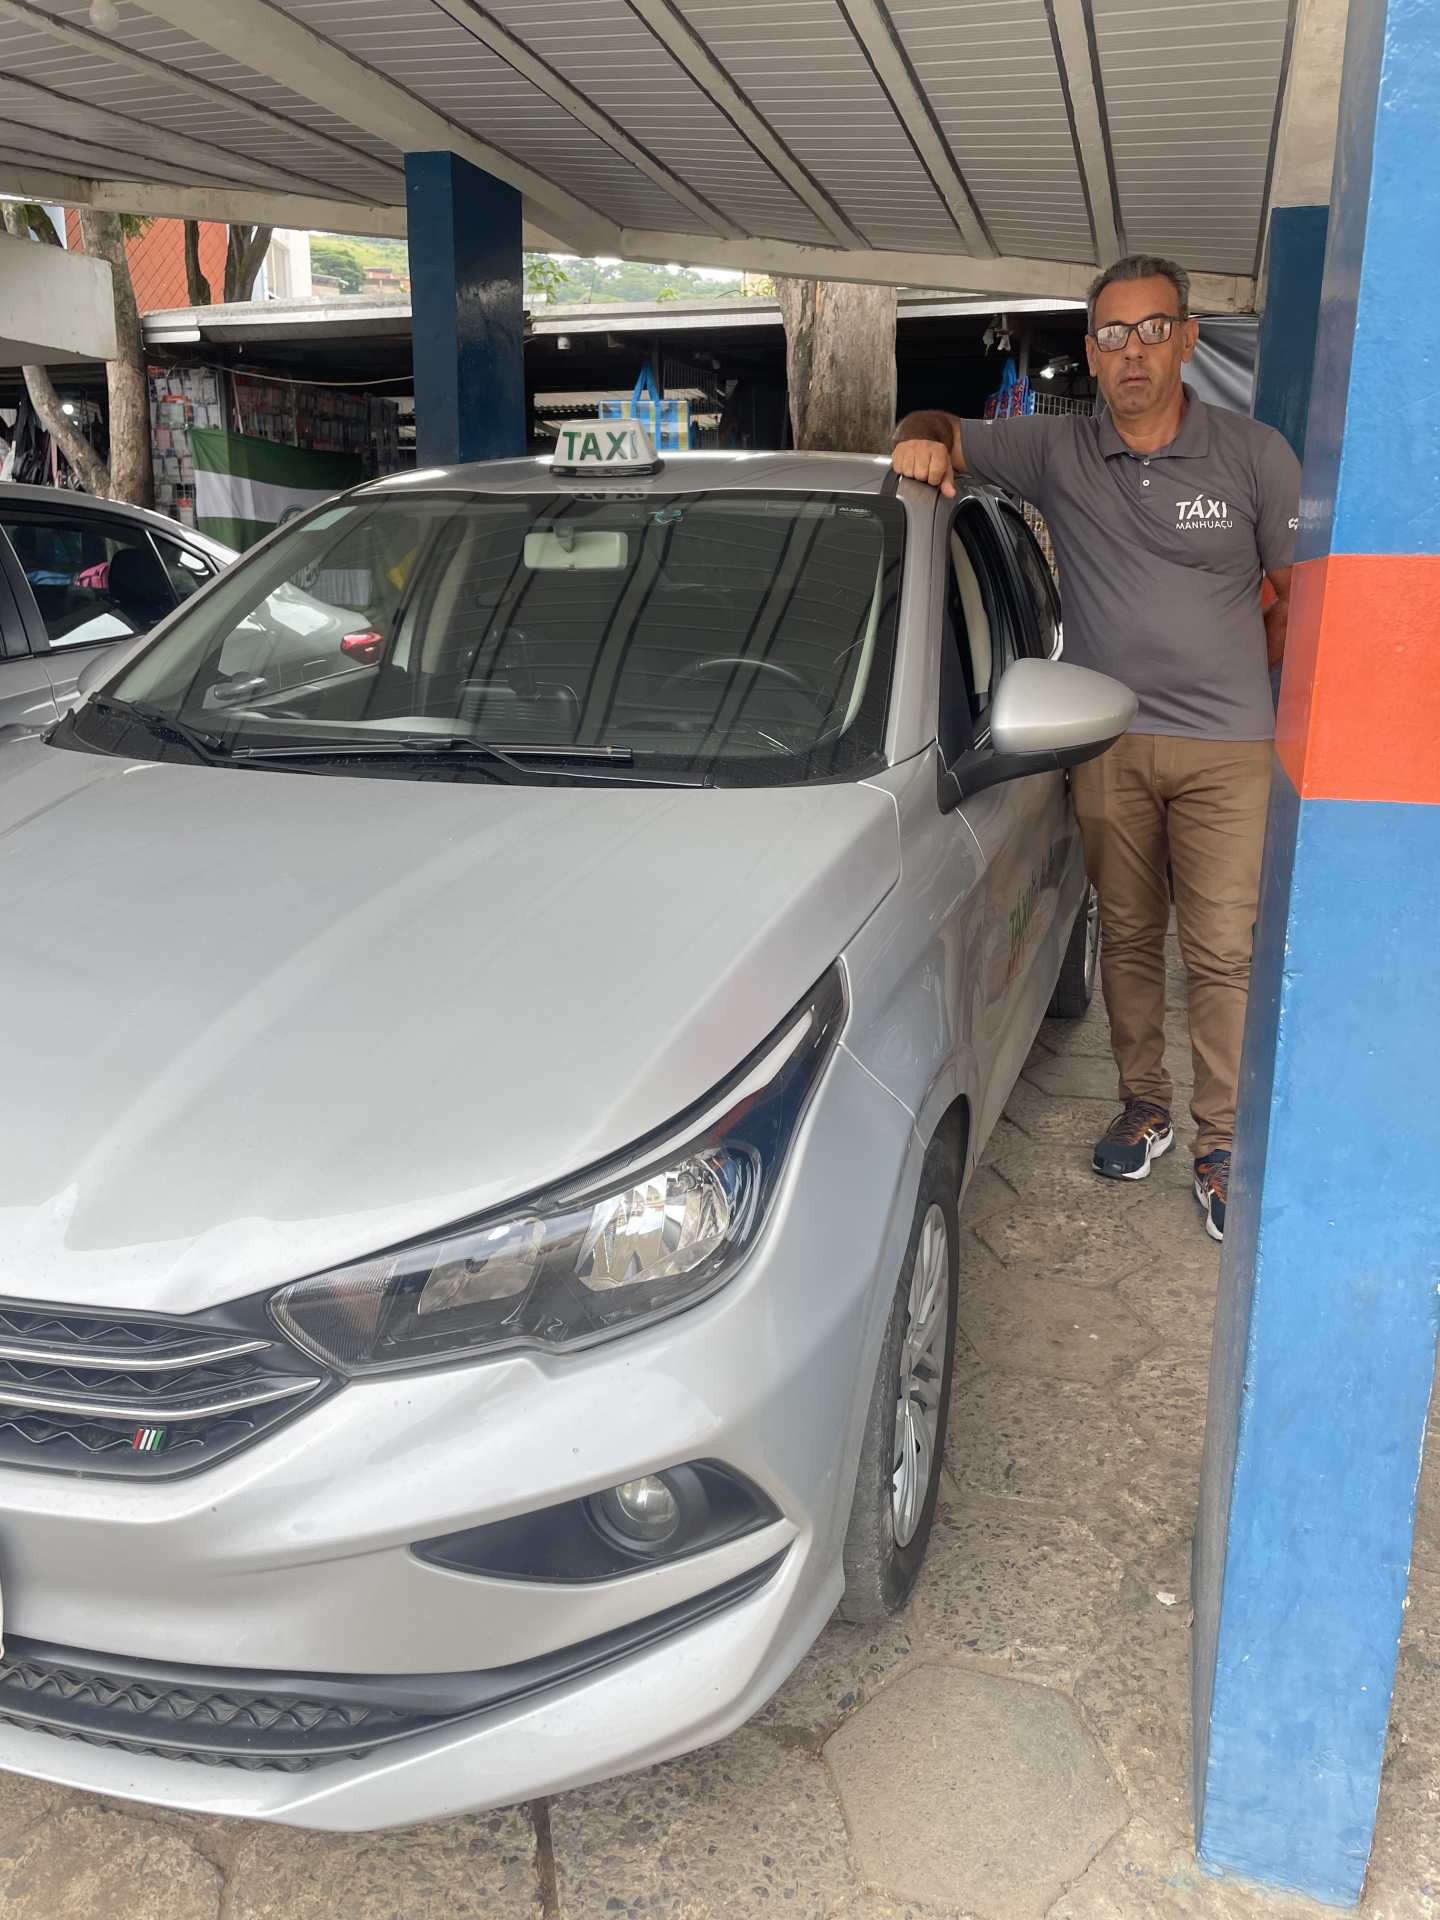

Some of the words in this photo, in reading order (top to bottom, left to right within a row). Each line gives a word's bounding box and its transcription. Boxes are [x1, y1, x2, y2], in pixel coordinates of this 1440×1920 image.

[563, 430, 637, 460] TAXI
[1176, 494, 1227, 520] TÁXI
[1176, 520, 1233, 530] MANHUAÇU
